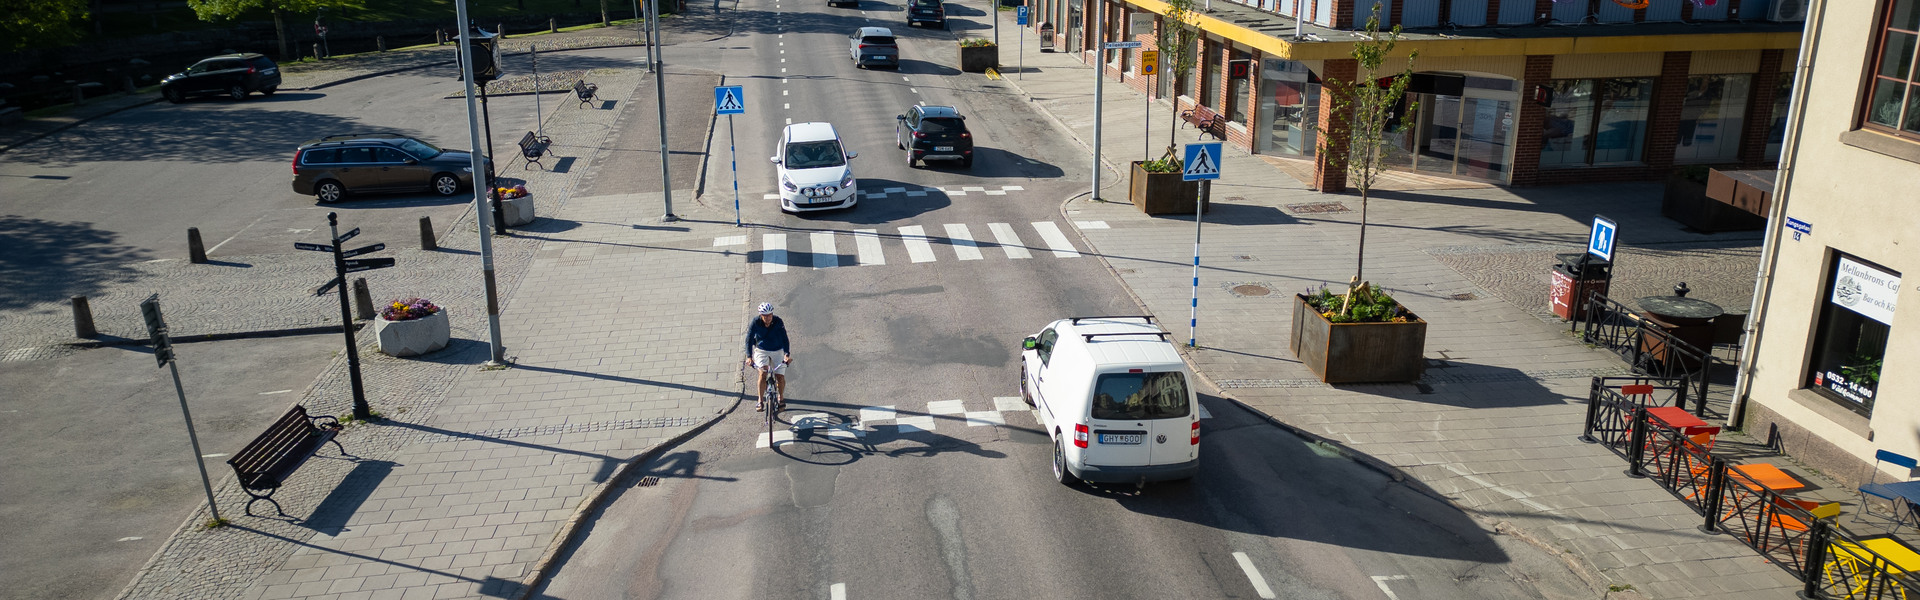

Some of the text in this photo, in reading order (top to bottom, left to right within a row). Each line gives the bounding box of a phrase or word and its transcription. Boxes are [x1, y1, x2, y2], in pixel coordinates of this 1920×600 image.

[1020, 7, 1026, 16] P
[1233, 64, 1246, 76] D
[1787, 218, 1811, 231] Kungsgatan
[1842, 263, 1885, 286] Mellanbrons
[1863, 293, 1873, 303] Bar
[1874, 299, 1885, 309] och
[1827, 371, 1844, 385] 0532
[1849, 381, 1858, 391] 14
[1858, 386, 1873, 398] 400
